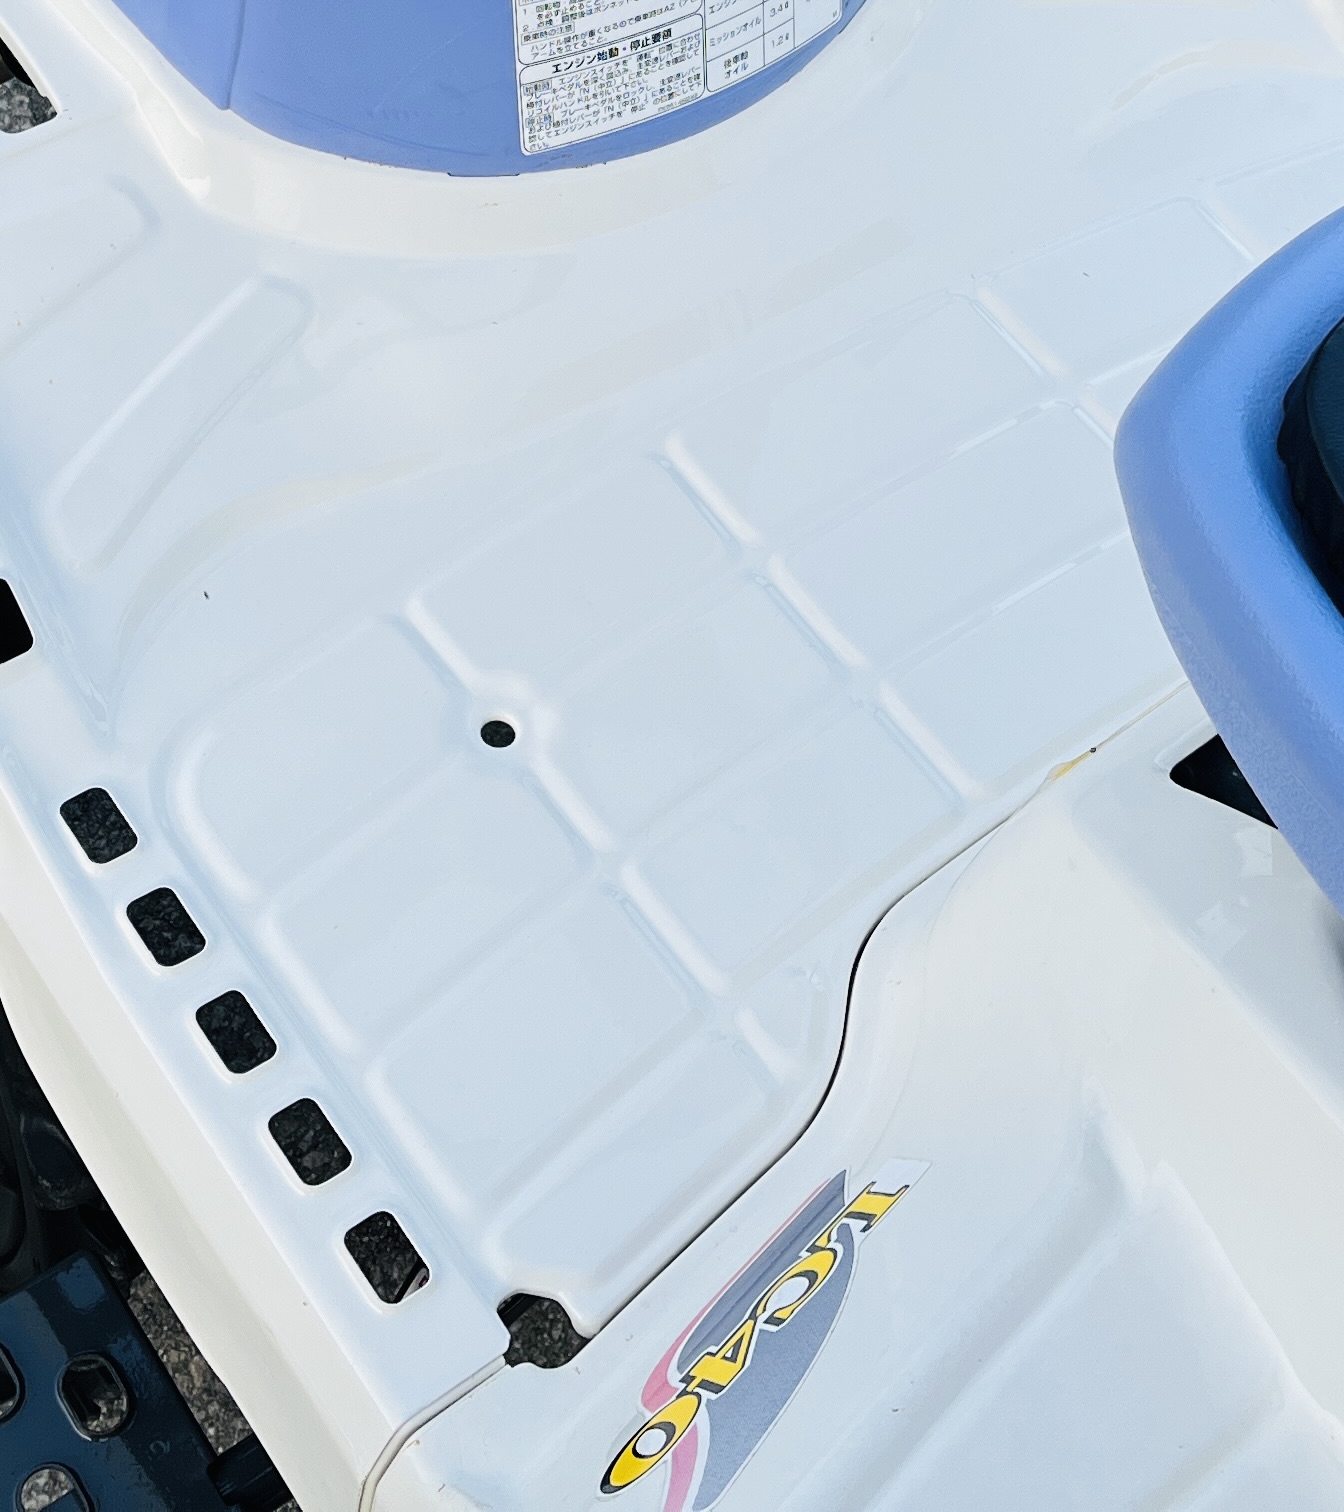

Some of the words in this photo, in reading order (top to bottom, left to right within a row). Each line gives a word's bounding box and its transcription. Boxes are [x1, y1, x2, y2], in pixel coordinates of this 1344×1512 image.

[709, 15, 761, 47] ミッションオイル
[551, 27, 672, 74] エンジン始動・停止要領
[724, 59, 748, 81] オイル
